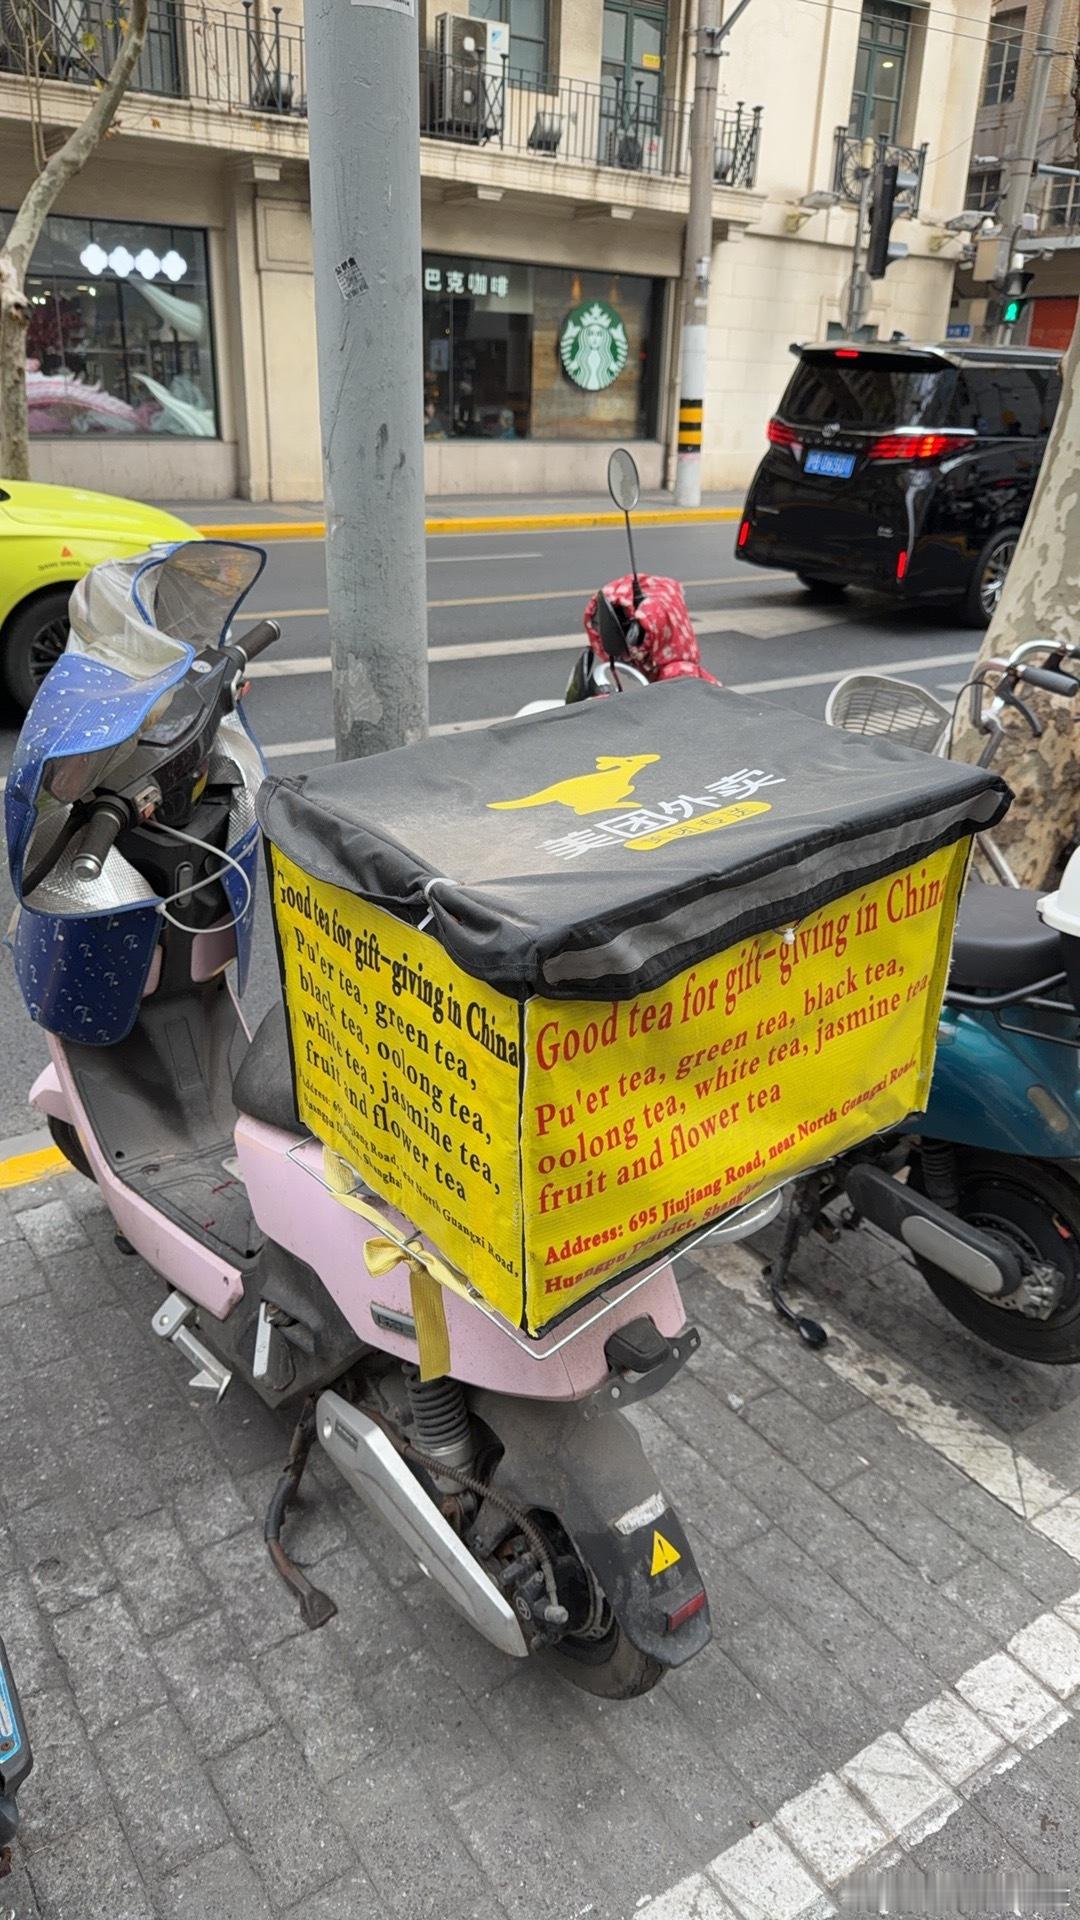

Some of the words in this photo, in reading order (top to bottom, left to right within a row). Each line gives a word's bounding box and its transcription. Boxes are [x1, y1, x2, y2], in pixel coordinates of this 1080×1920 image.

[424, 268, 509, 298] 巴克咖啡
[534, 768, 786, 860] 美团外卖
[294, 926, 334, 981] Pu'er
[339, 968, 368, 1015] tea,
[375, 1000, 428, 1054] green
[434, 1040, 476, 1091] tea,
[299, 964, 336, 1021] black
[341, 1008, 370, 1055] tea,
[378, 1042, 443, 1114] oolong
[449, 1093, 491, 1145] tea,
[314, 898, 330, 936] tea
[332, 909, 351, 953] for
[355, 929, 443, 1025] gift-giving
[447, 983, 462, 1030] in
[466, 1002, 518, 1068] China
[535, 1084, 609, 1137] Pu'er
[618, 1065, 666, 1097] tea,
[675, 1030, 747, 1080] green
[756, 1011, 796, 1040] tea,
[804, 966, 858, 1016] black
[865, 958, 904, 985] tea,
[536, 1000, 619, 1071] Good
[629, 1002, 673, 1038] tea
[681, 972, 719, 1024] for
[855, 893, 878, 936] in
[302, 1009, 343, 1058] white
[345, 1048, 374, 1094] tea,
[381, 1071, 452, 1153] jasmine
[460, 1142, 500, 1194] tea,
[306, 1040, 341, 1087] fruit
[373, 1104, 428, 1173] flower
[435, 1161, 467, 1202] tea
[538, 1116, 638, 1174] oolong
[643, 1095, 686, 1129] tea,
[694, 1056, 760, 1100] white
[768, 1037, 809, 1066] tea,
[815, 991, 900, 1054] jasmine
[538, 1170, 607, 1214] fruit
[617, 1137, 664, 1185] and
[670, 1102, 739, 1160] flower
[747, 1084, 781, 1113] tea
[370, 1141, 399, 1169] Road,
[443, 1208, 486, 1248] Guangxi
[488, 1242, 519, 1278] Road,
[544, 1223, 624, 1266] Address:
[628, 1208, 658, 1232] 695
[660, 1178, 721, 1224] Jiujiang
[724, 1150, 766, 1186] Road,
[768, 1133, 797, 1160] near
[797, 1107, 838, 1141] North
[841, 1074, 888, 1117] Guangxi
